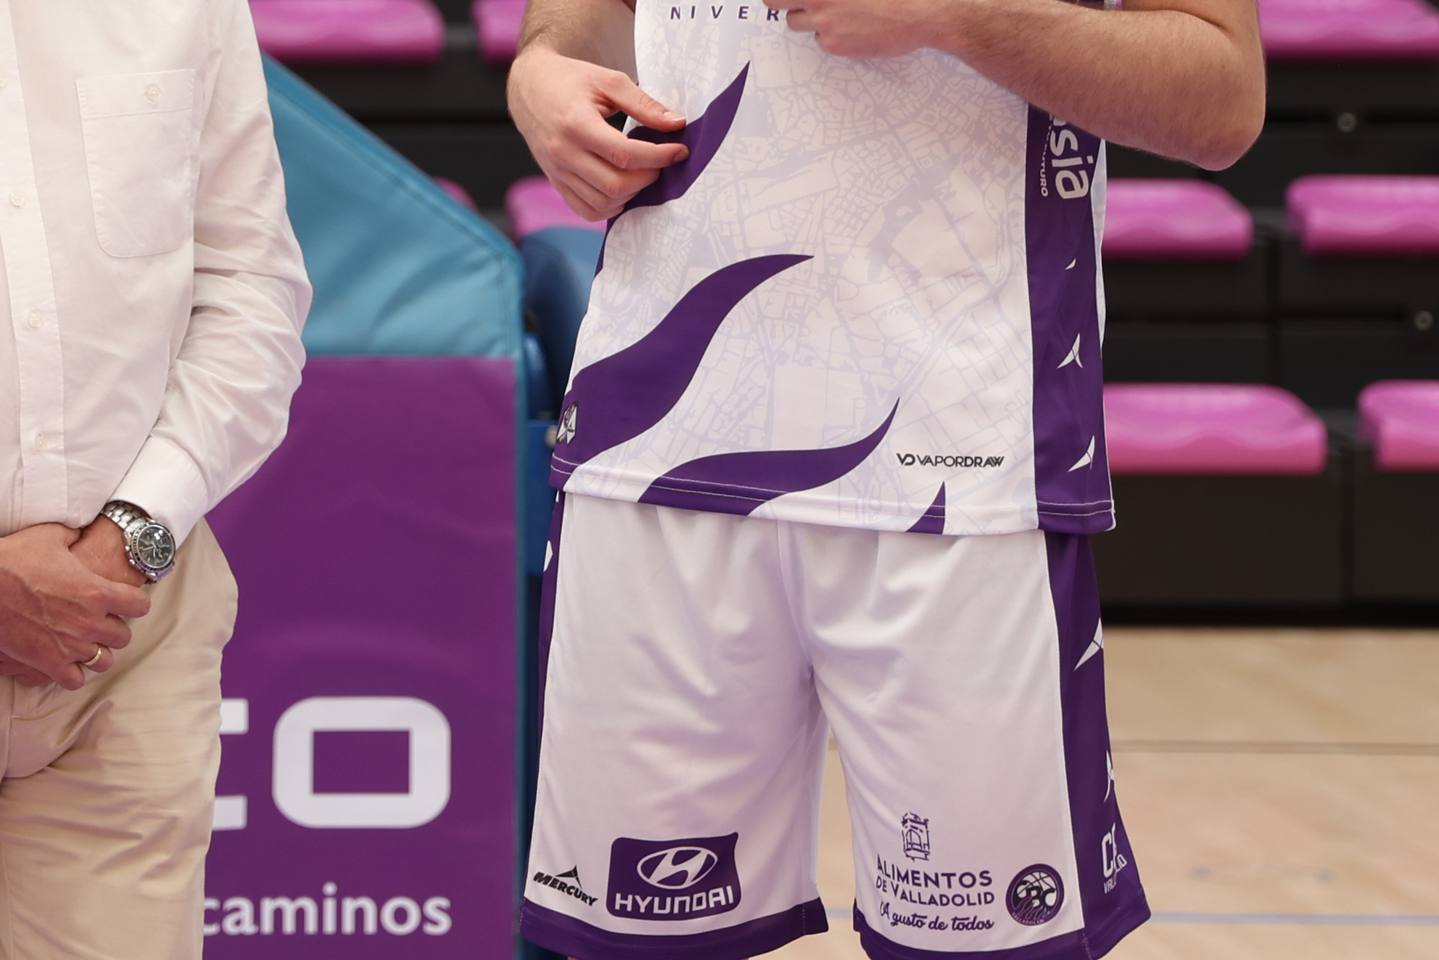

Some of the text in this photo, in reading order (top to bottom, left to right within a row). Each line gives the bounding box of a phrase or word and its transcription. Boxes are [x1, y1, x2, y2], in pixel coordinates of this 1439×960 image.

[669, 4, 781, 22] NIVER
[916, 454, 1005, 468] VAPORDRAW
[876, 853, 993, 890] ALIMENTOS
[532, 871, 599, 907] MERCURY
[614, 885, 735, 915] HYUNDAI
[876, 875, 995, 907] DE VALLADOLID
[891, 913, 928, 928] gusto
[928, 916, 949, 931] de
[951, 915, 995, 931] todos
